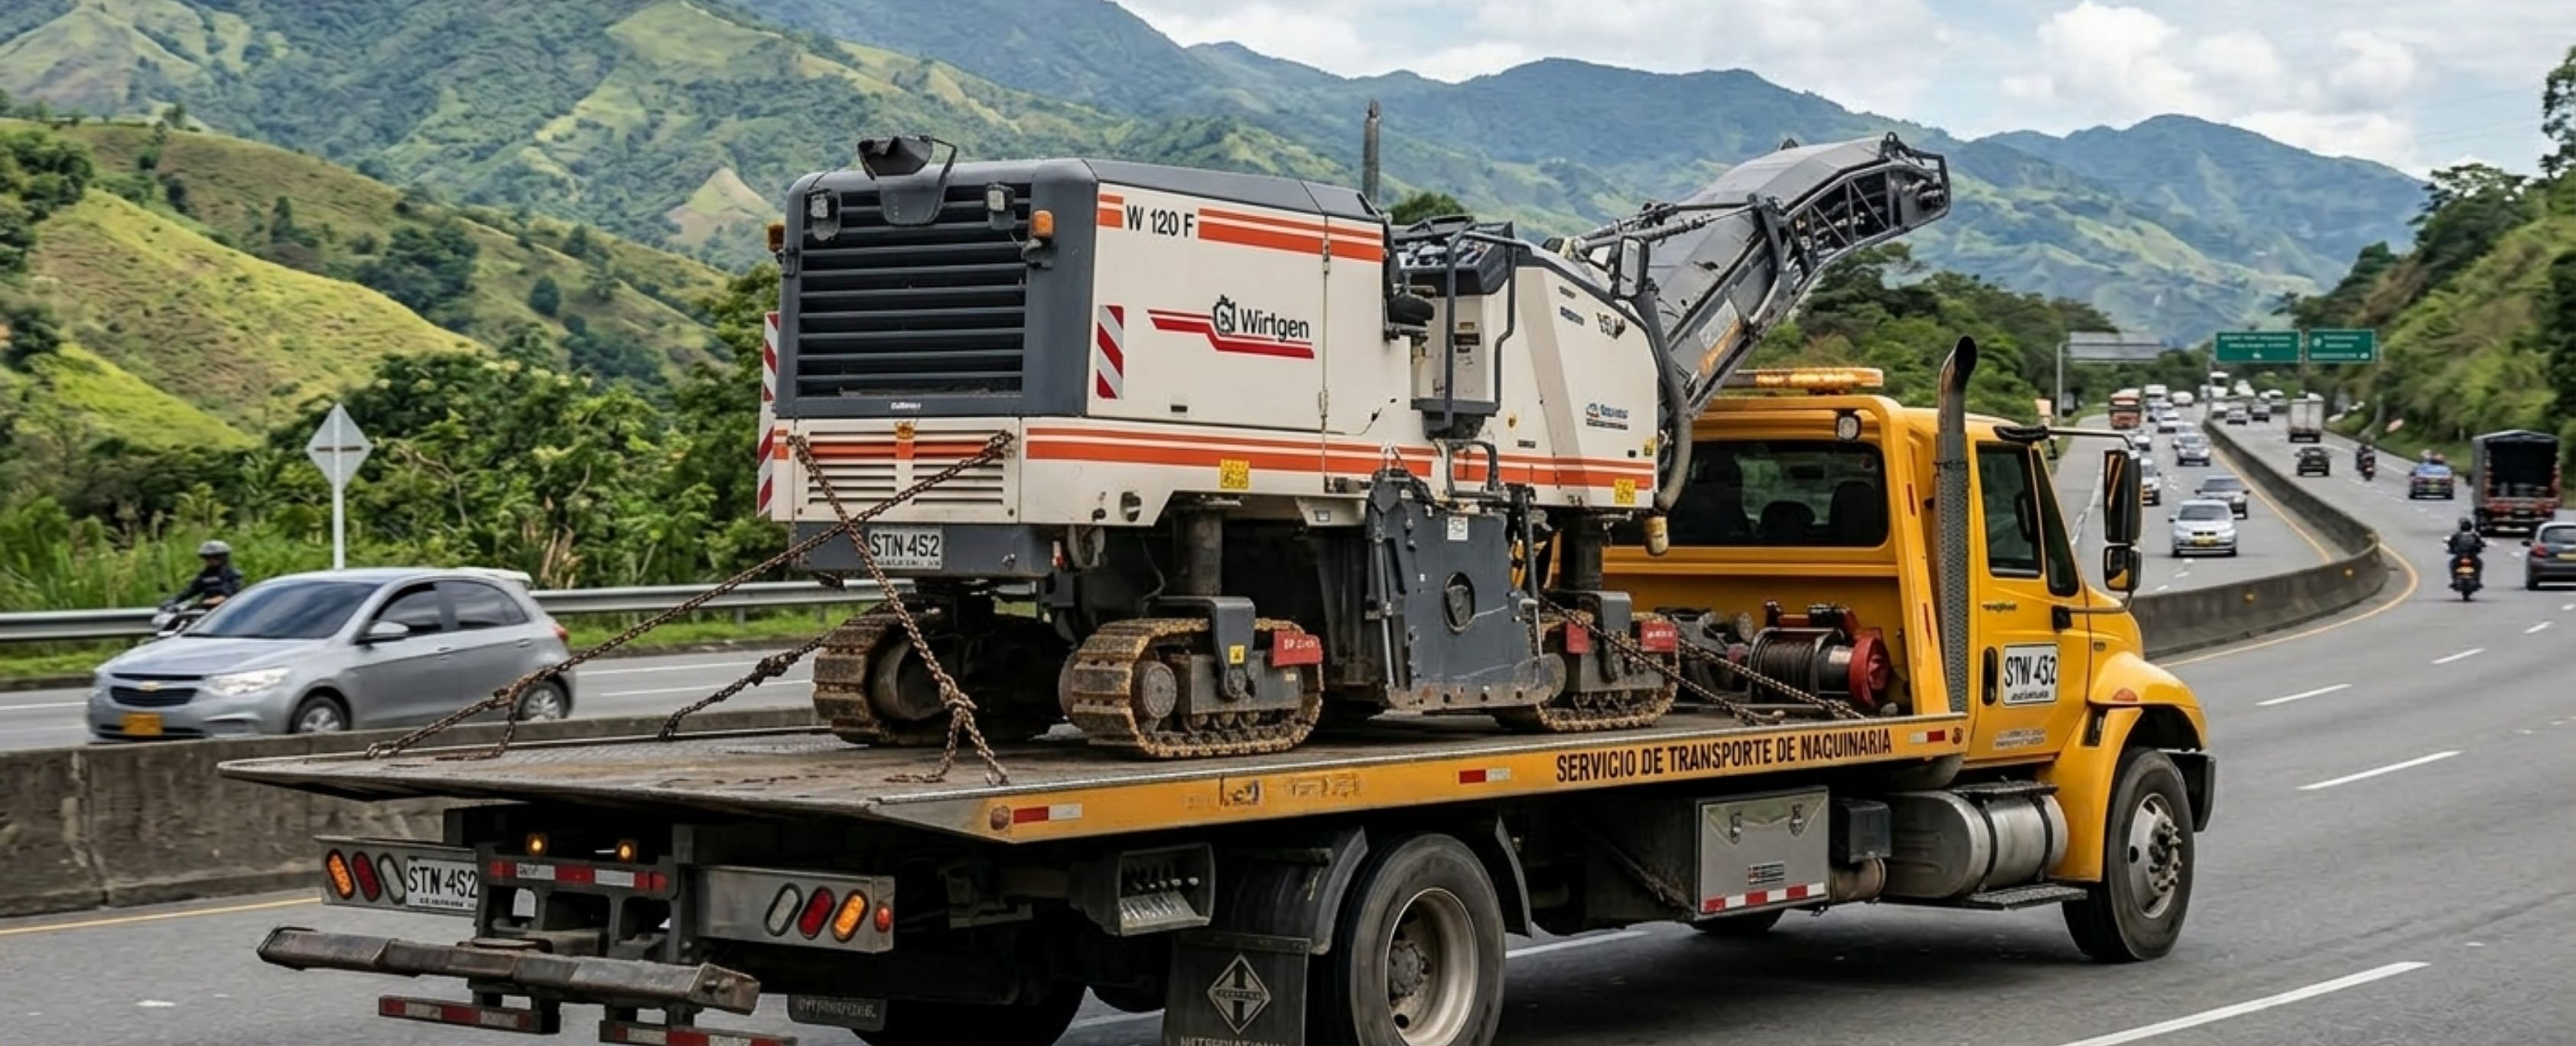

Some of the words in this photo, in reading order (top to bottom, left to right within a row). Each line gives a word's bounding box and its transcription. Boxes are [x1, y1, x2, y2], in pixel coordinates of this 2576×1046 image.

[1127, 205, 1144, 231] W
[1150, 208, 1179, 236] 120
[1184, 213, 1195, 238] F
[1240, 307, 1309, 342] Wirtgen
[871, 534, 903, 557] STN
[1556, 749, 1636, 783] SERVICIO
[1641, 746, 1664, 775] DE
[1667, 737, 1773, 772] TRANSPORTE
[1777, 736, 1796, 763] DE
[408, 866, 441, 895] STN
